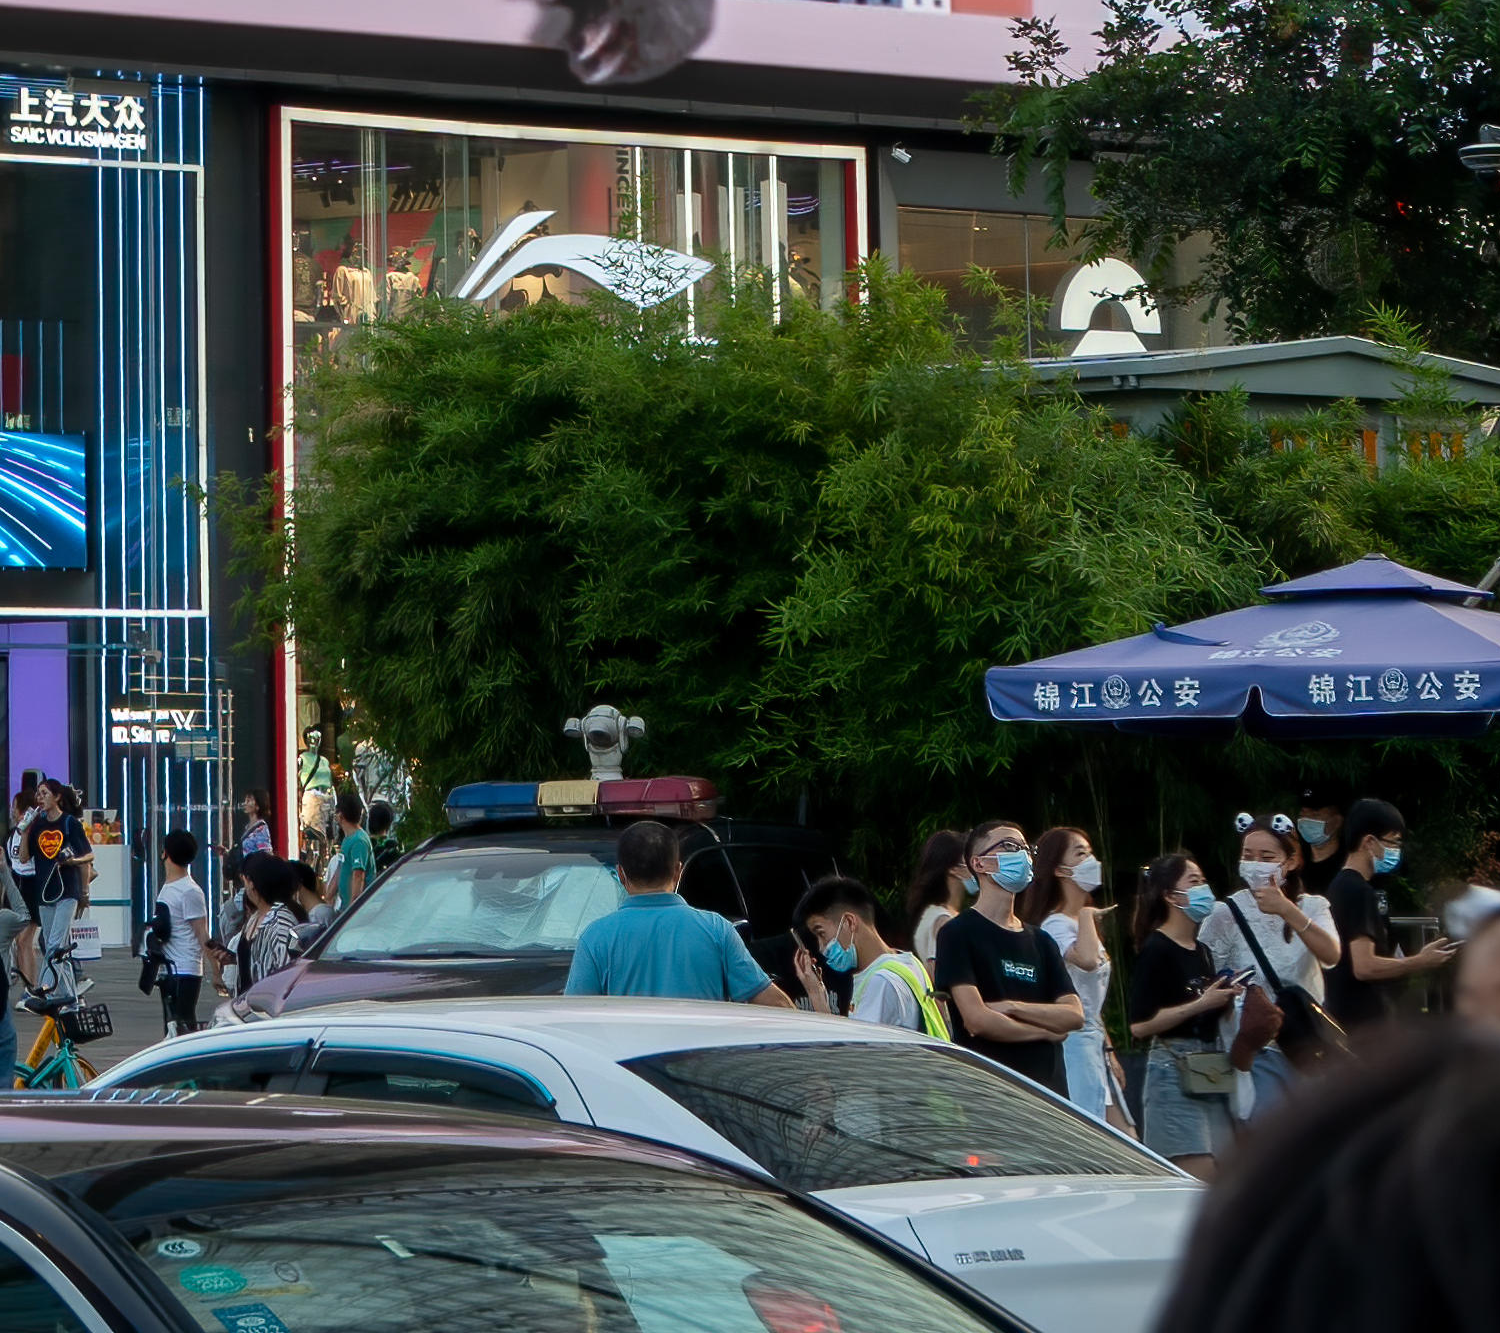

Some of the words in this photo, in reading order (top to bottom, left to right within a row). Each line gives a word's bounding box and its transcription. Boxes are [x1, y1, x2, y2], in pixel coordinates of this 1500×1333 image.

[9, 86, 146, 131] 上汽大众
[1033, 676, 1201, 711] 锦江公安
[1308, 669, 1482, 705] 锦江公安
